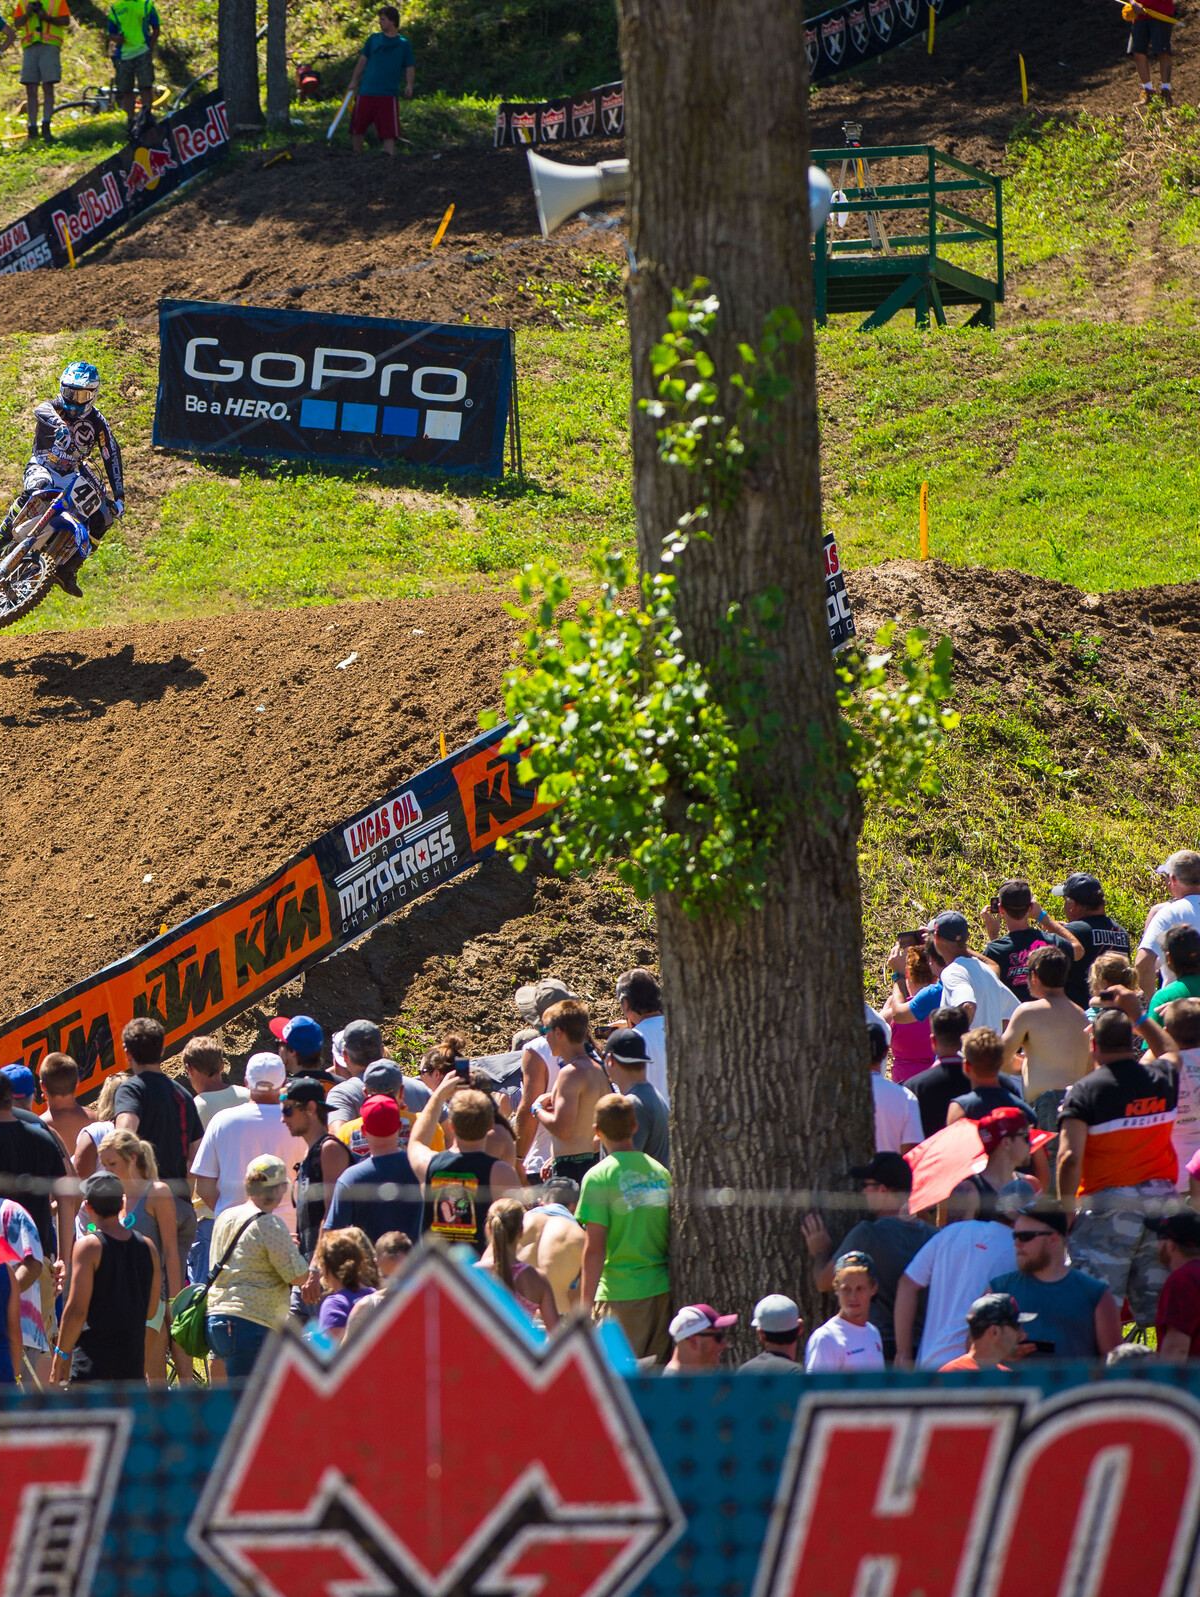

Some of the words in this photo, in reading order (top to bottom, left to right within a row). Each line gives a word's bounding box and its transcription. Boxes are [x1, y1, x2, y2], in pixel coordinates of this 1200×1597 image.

[855, 23, 866, 45] X
[877, 11, 890, 34] X
[829, 33, 841, 57] X
[579, 116, 590, 137] X
[608, 107, 619, 131] X
[13, 222, 29, 247] OIL
[184, 337, 467, 402] GoPro
[185, 394, 207, 414] Be
[210, 401, 222, 415] a
[224, 397, 292, 422] HERO.
[73, 483, 101, 517] 46
[350, 808, 390, 858] LUCAS
[392, 794, 418, 831] OIL
[371, 837, 403, 864] PRO
[338, 824, 456, 921] MOTOCROSS
[342, 855, 459, 933] CHAMPIONSHIP
[235, 881, 321, 988] KTM
[133, 944, 224, 1033] KTM
[1125, 1096, 1166, 1116] KTM
